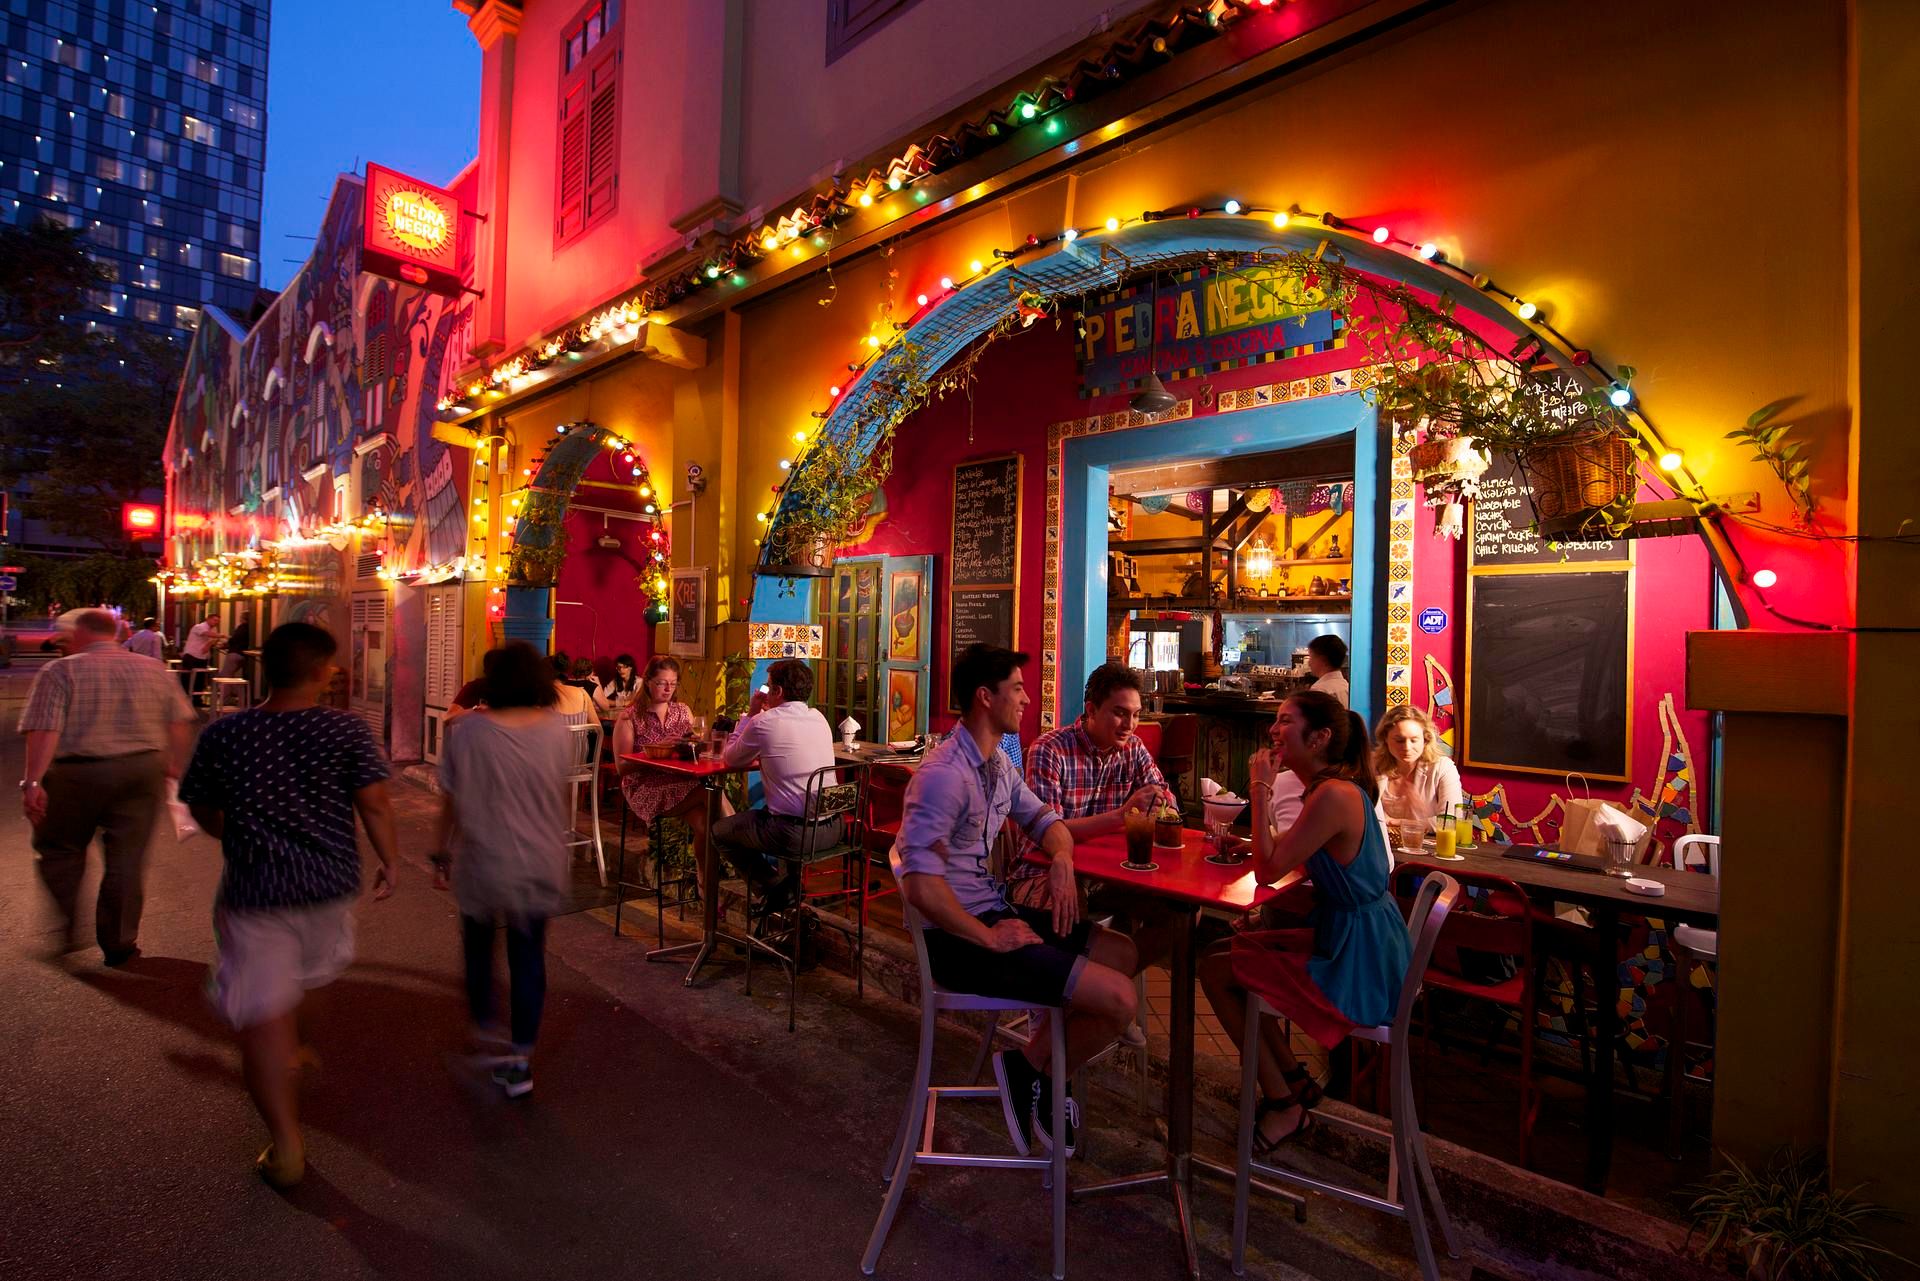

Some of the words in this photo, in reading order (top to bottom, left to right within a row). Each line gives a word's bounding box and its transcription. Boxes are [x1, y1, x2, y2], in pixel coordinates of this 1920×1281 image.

[393, 197, 446, 228] PIEDRA
[395, 213, 440, 242] NEGRA
[1086, 290, 1200, 361] PIEDRA
[1211, 325, 1286, 359] COCINA
[1424, 615, 1443, 625] ADT
